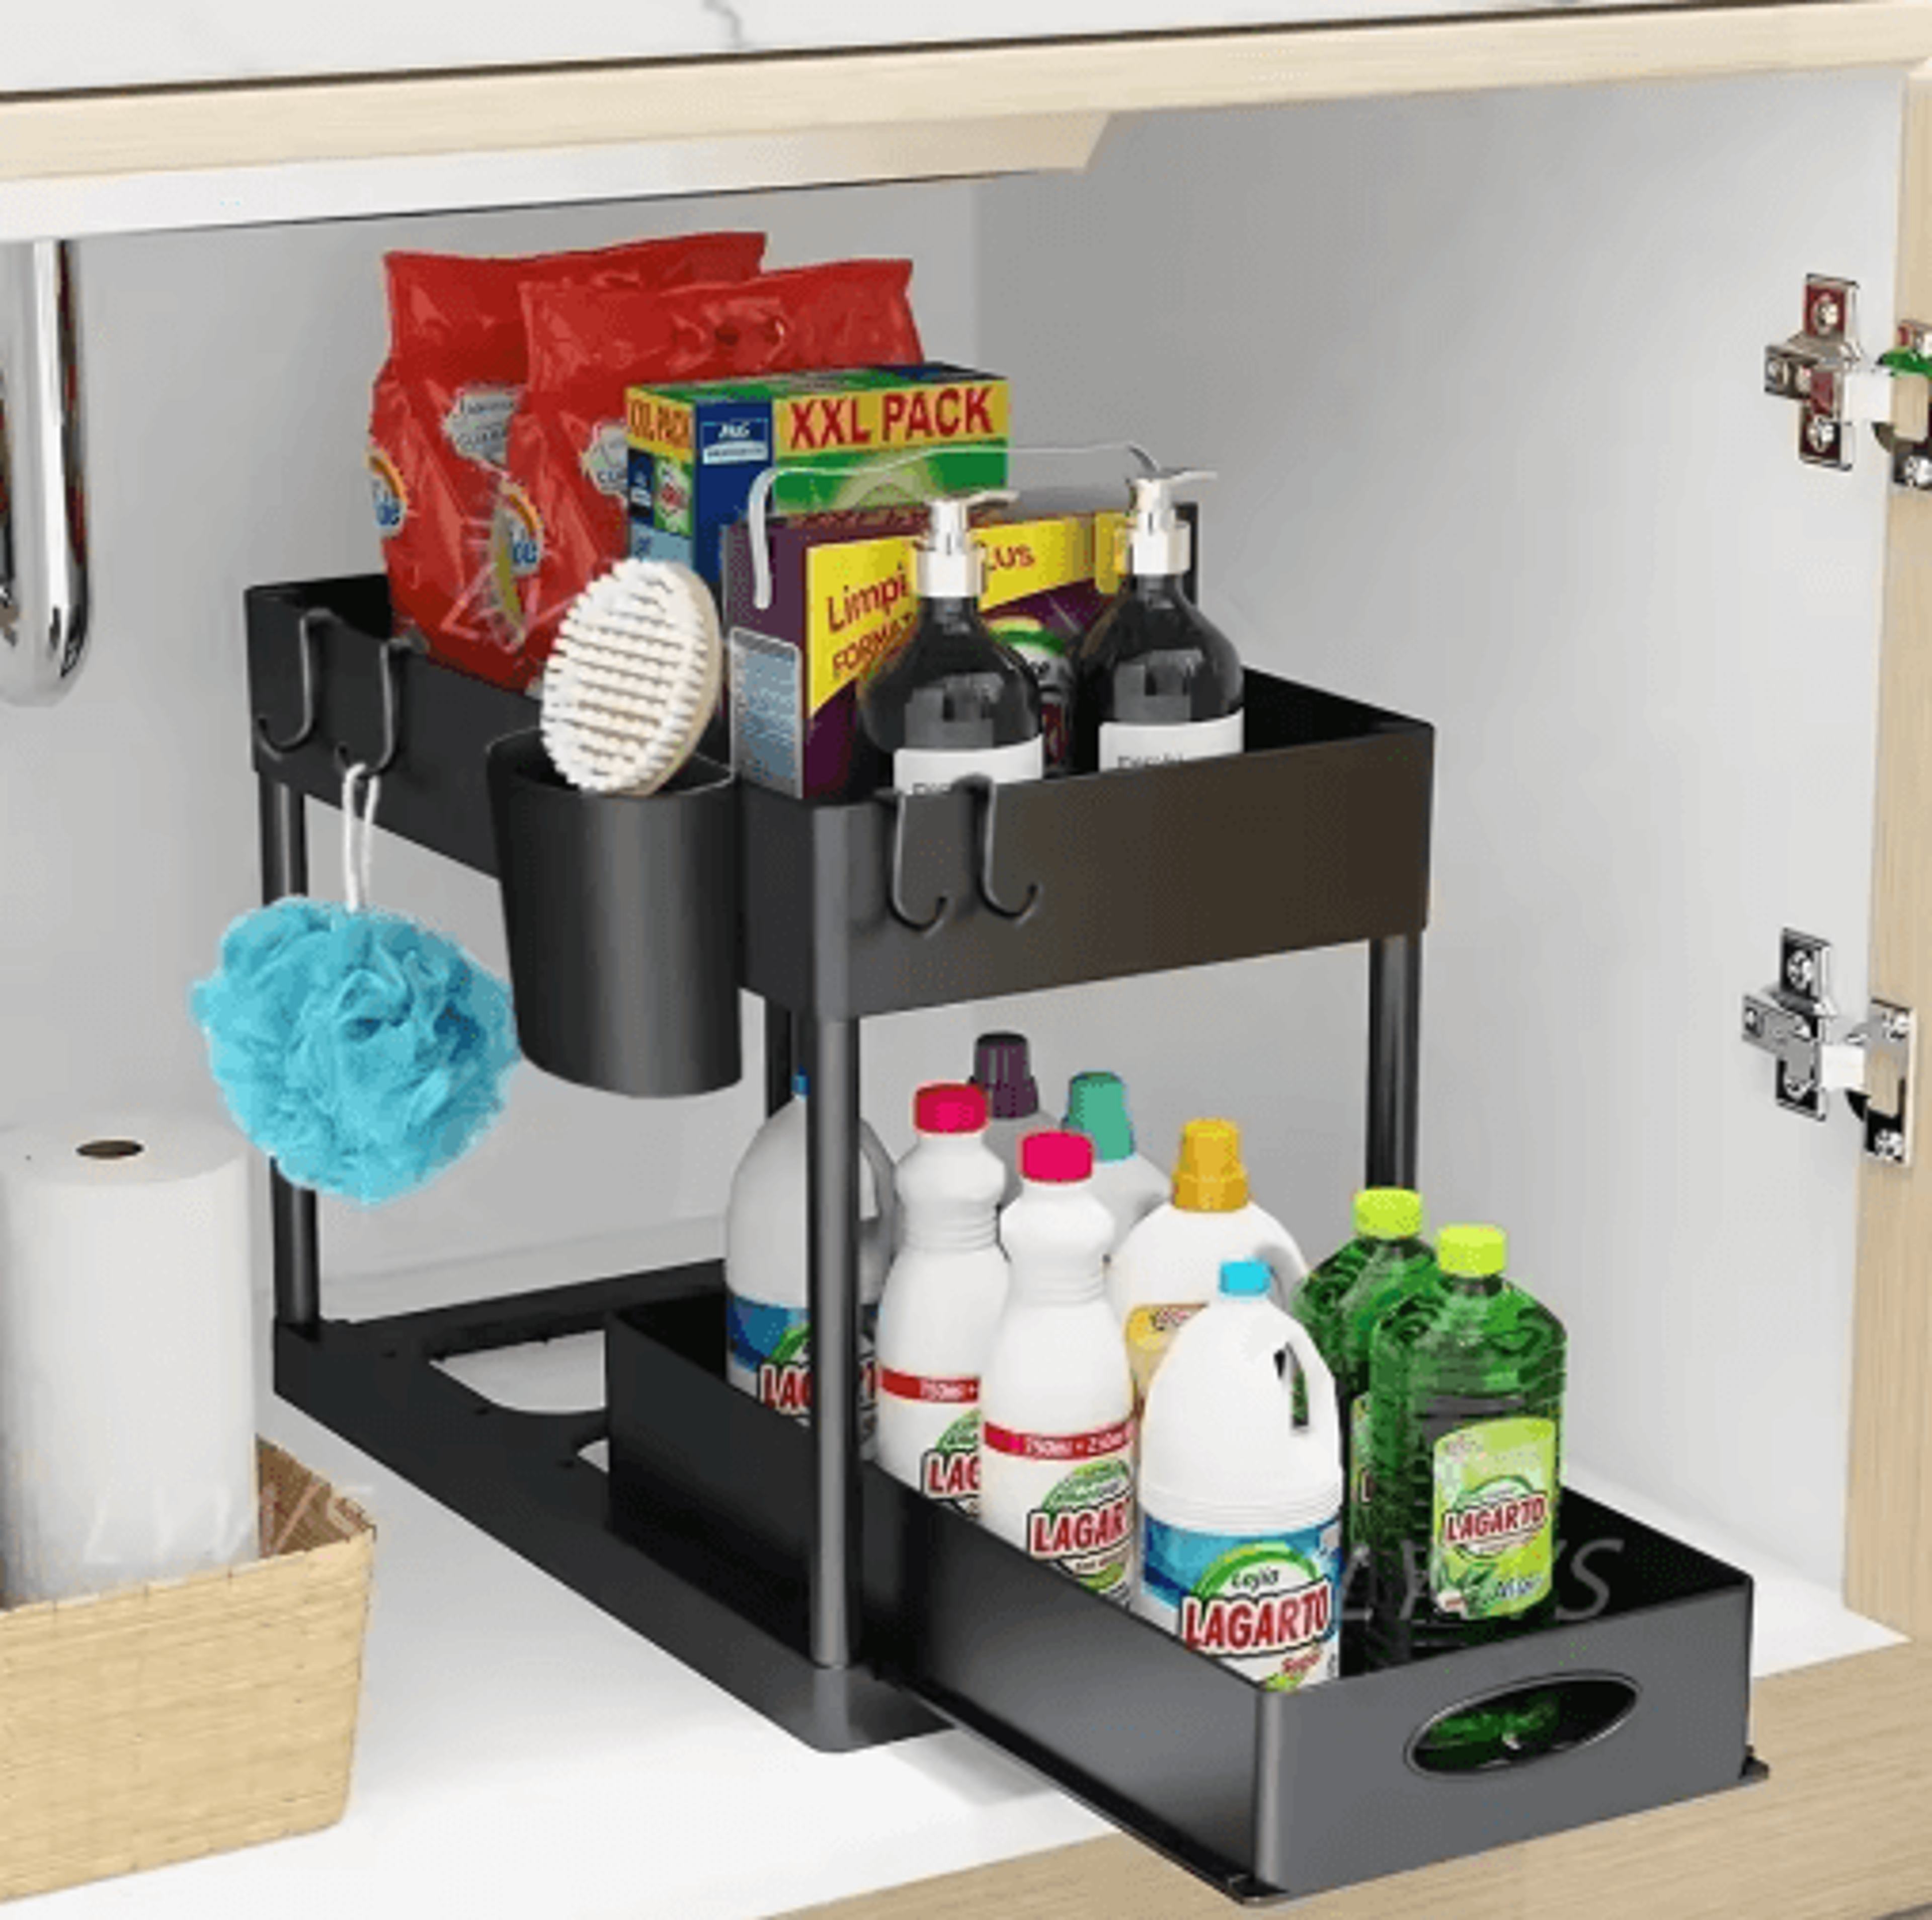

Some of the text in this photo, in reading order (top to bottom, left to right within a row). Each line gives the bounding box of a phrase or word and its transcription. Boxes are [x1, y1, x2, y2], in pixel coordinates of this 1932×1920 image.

[790, 387, 994, 449] XXL PACK
[1445, 1496, 1545, 1540] LAGARTO
[1185, 1584, 1329, 1651] LAGARTO
